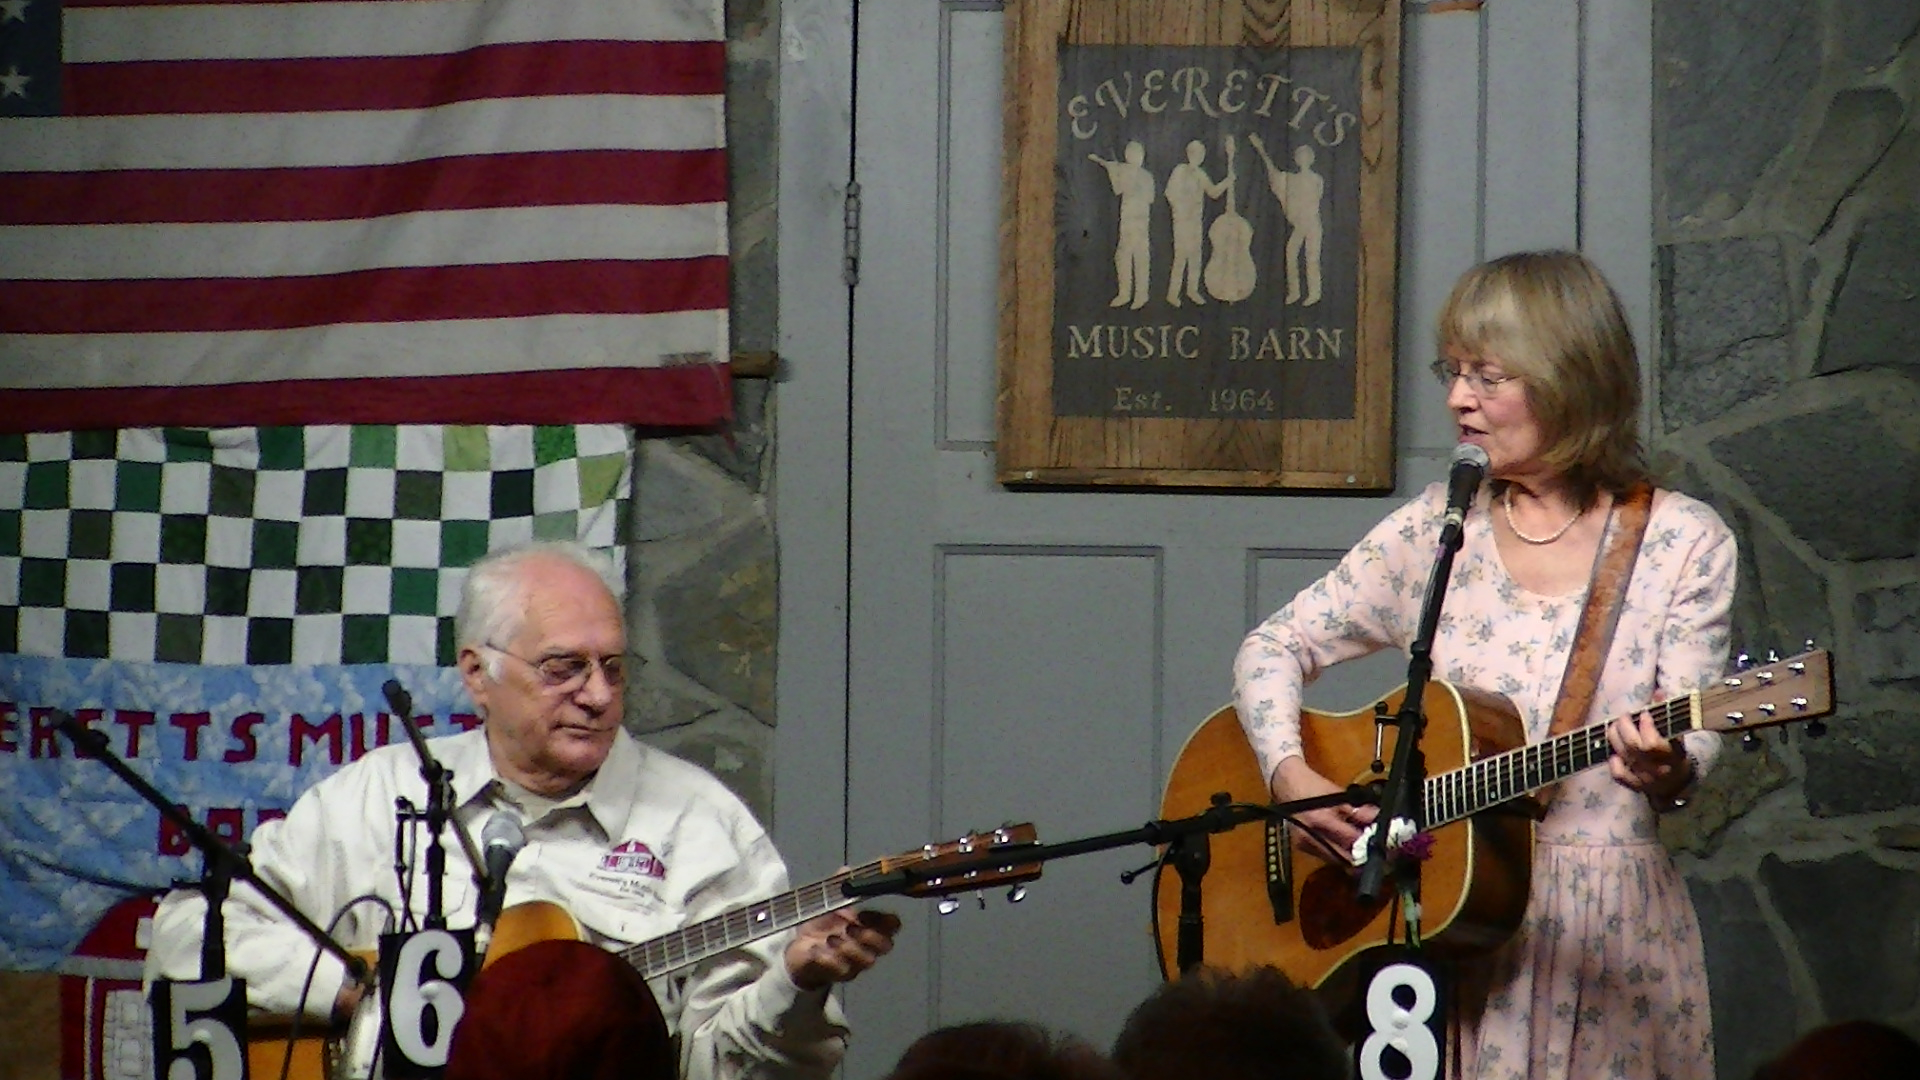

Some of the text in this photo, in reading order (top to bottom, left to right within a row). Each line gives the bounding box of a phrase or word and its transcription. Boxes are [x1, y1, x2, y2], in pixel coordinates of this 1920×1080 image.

[1067, 67, 1357, 147] EVERETT'S
[1068, 324, 1343, 361] MUSIC BARN
[1113, 387, 1275, 412] Est. 1964
[170, 977, 243, 1080] 5
[390, 930, 464, 1066] 6
[1360, 963, 1439, 1080] 8
